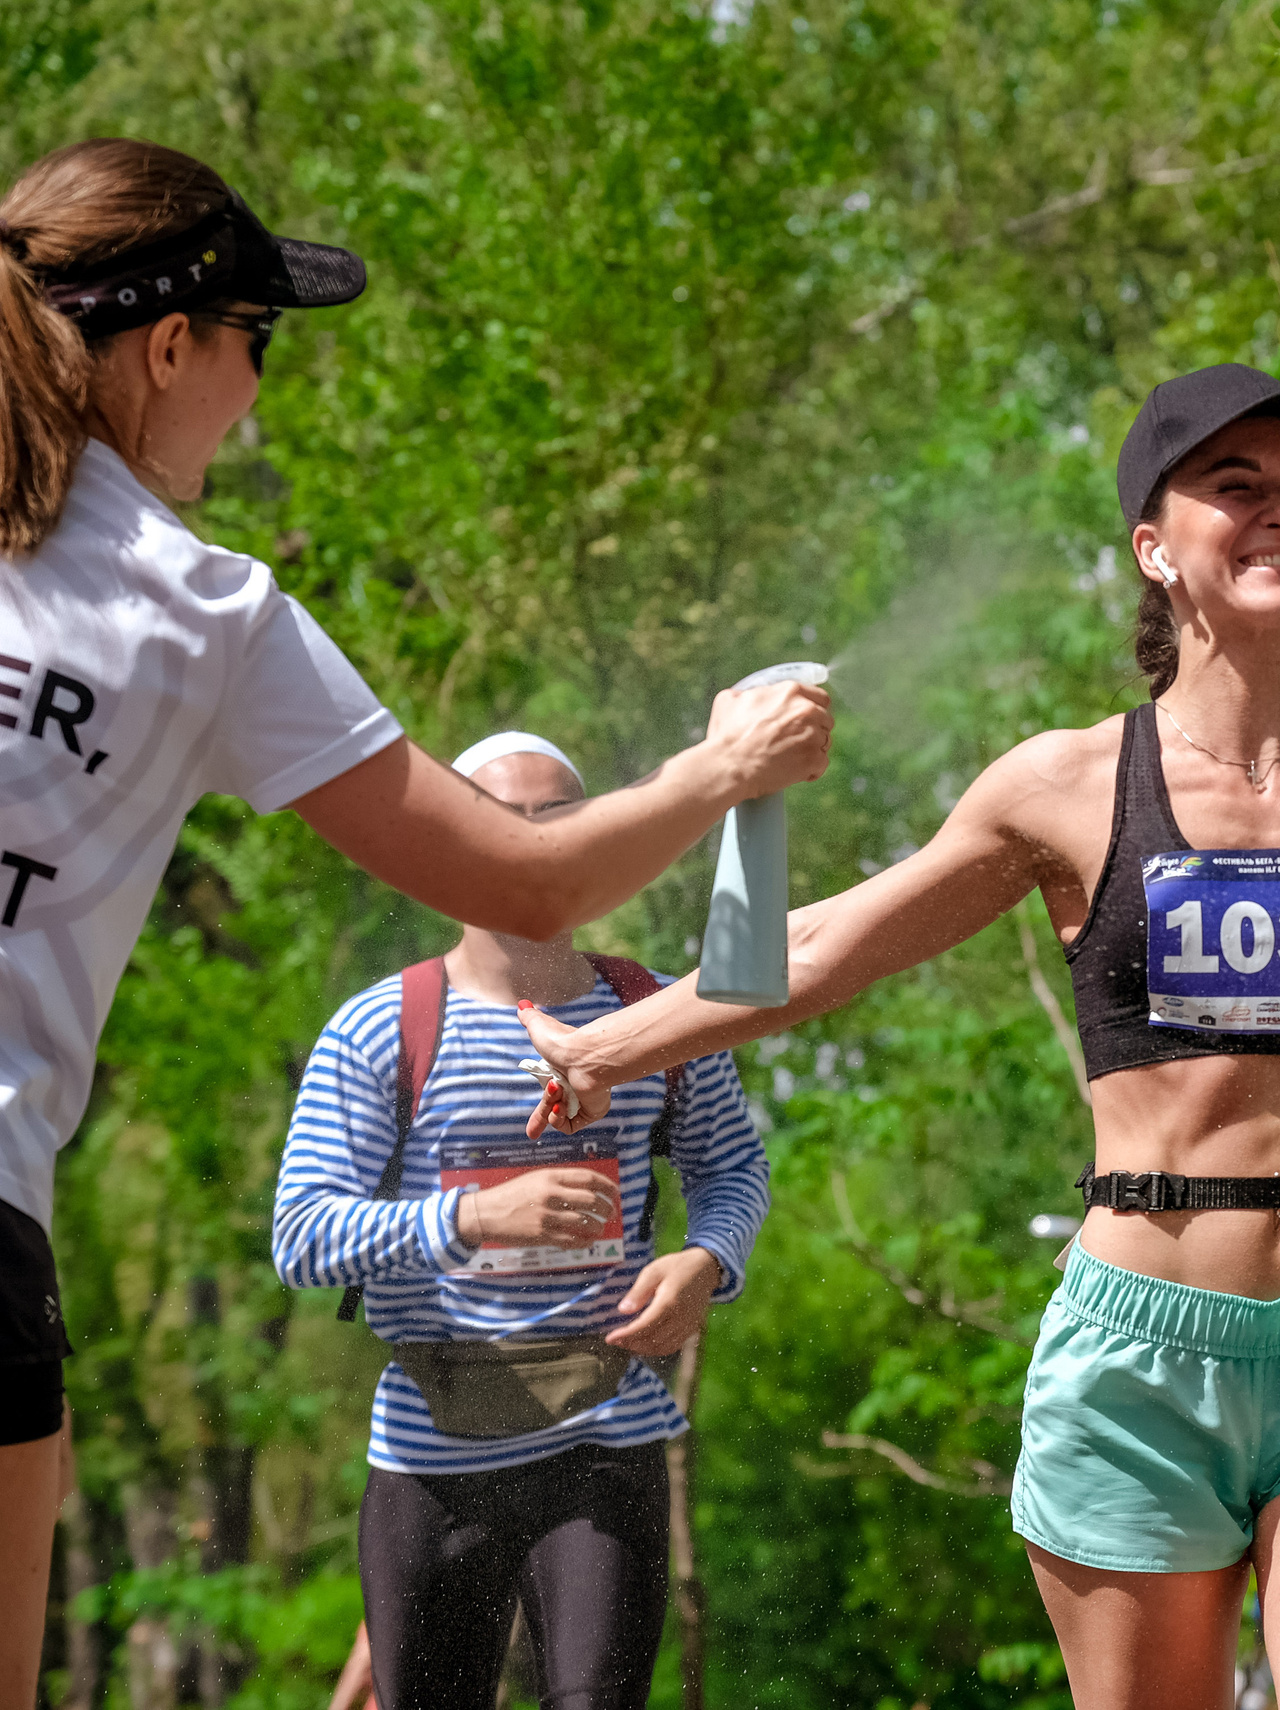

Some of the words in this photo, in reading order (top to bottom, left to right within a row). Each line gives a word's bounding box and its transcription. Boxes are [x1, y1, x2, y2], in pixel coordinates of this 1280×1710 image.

[50, 263, 202, 315] PORT
[1212, 857, 1255, 866] ФЕСТИВАЛЬ
[1255, 857, 1274, 866] БЕГА
